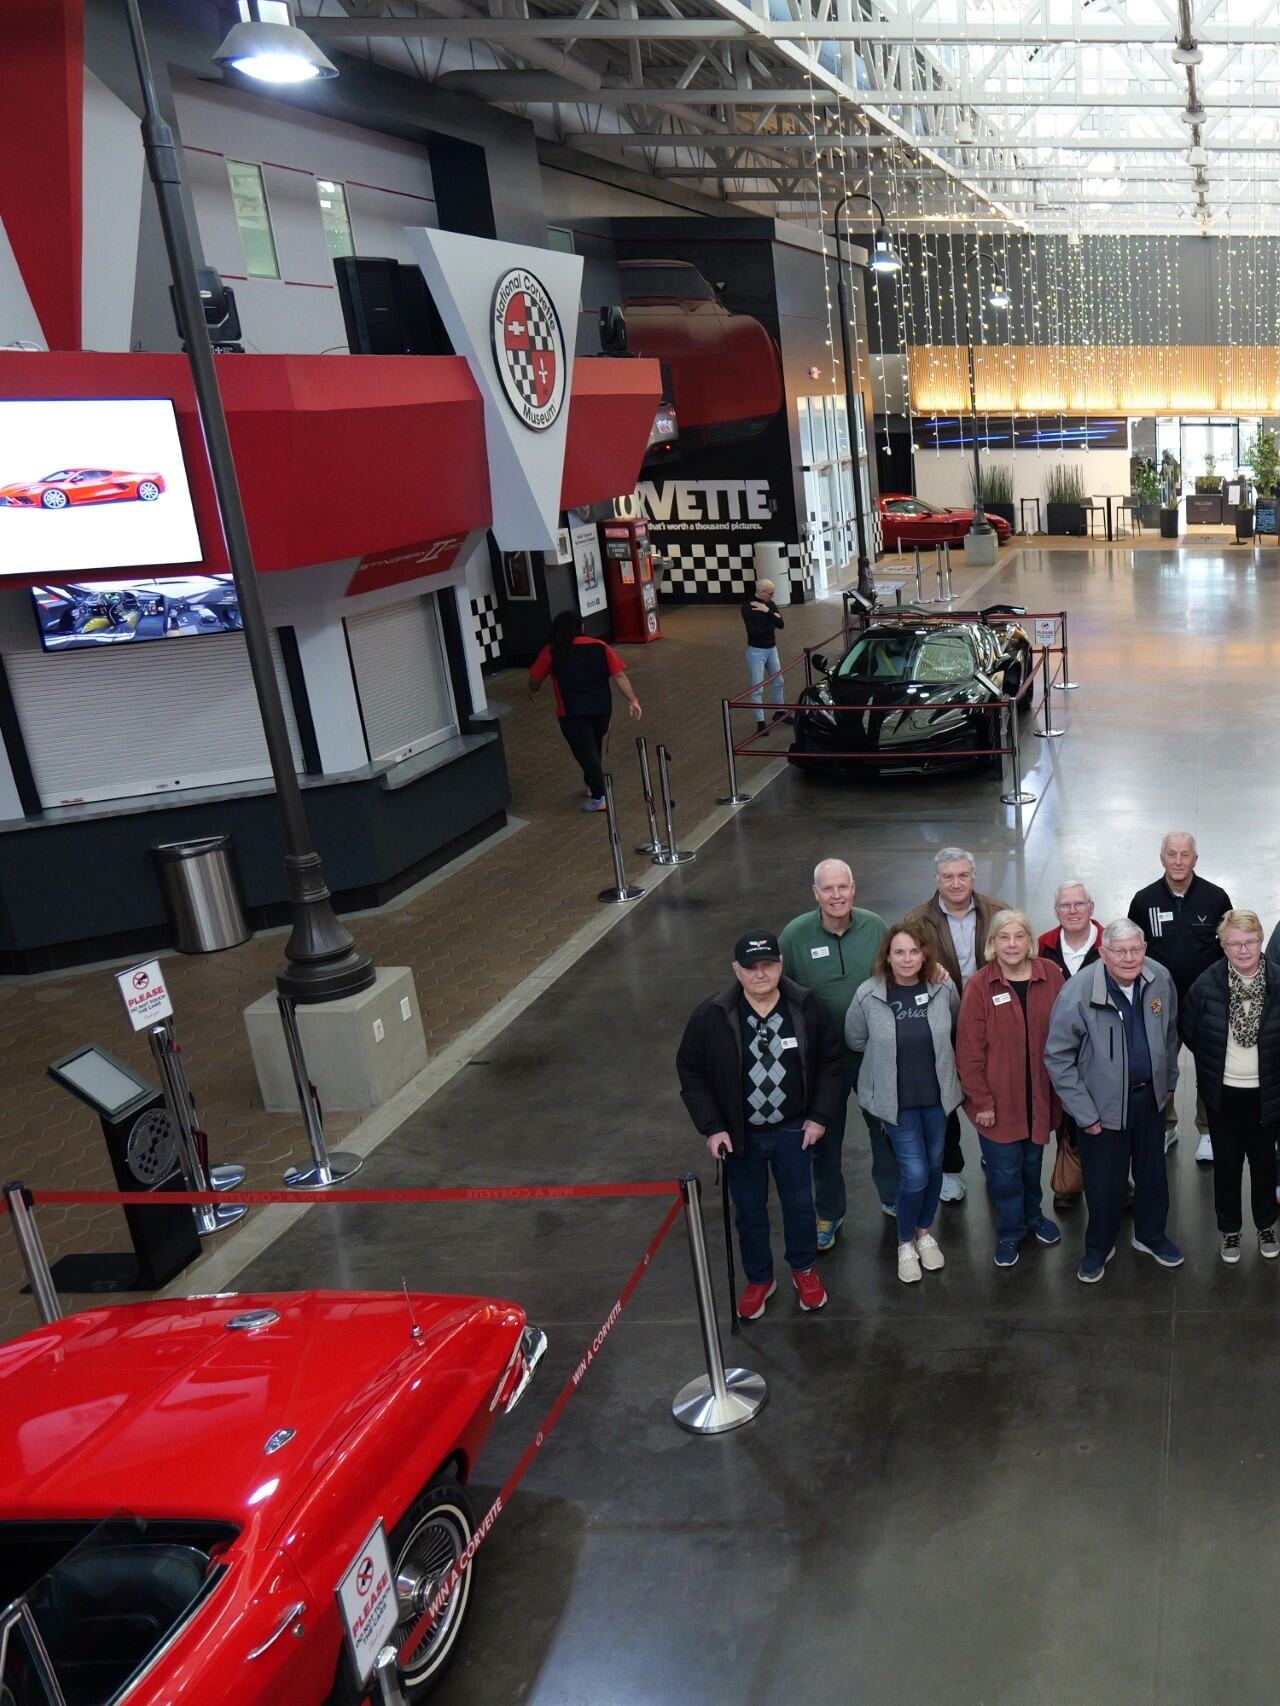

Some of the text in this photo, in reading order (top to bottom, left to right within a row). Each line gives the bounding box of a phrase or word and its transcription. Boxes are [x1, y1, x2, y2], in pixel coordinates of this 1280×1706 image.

[496, 273, 556, 331] National Corvette
[523, 403, 556, 425] Museum
[667, 522, 689, 530] worth
[695, 522, 729, 530] thousand
[128, 986, 164, 1007] PLEASE
[148, 1001, 162, 1009] CARS
[150, 994, 166, 1004] TOUCH
[572, 1299, 622, 1385] WIN A CORVETTE
[428, 1497, 503, 1619] WIN A CORVETTE
[352, 1570, 389, 1639] PLEASE
[364, 1615, 374, 1634] NOT
